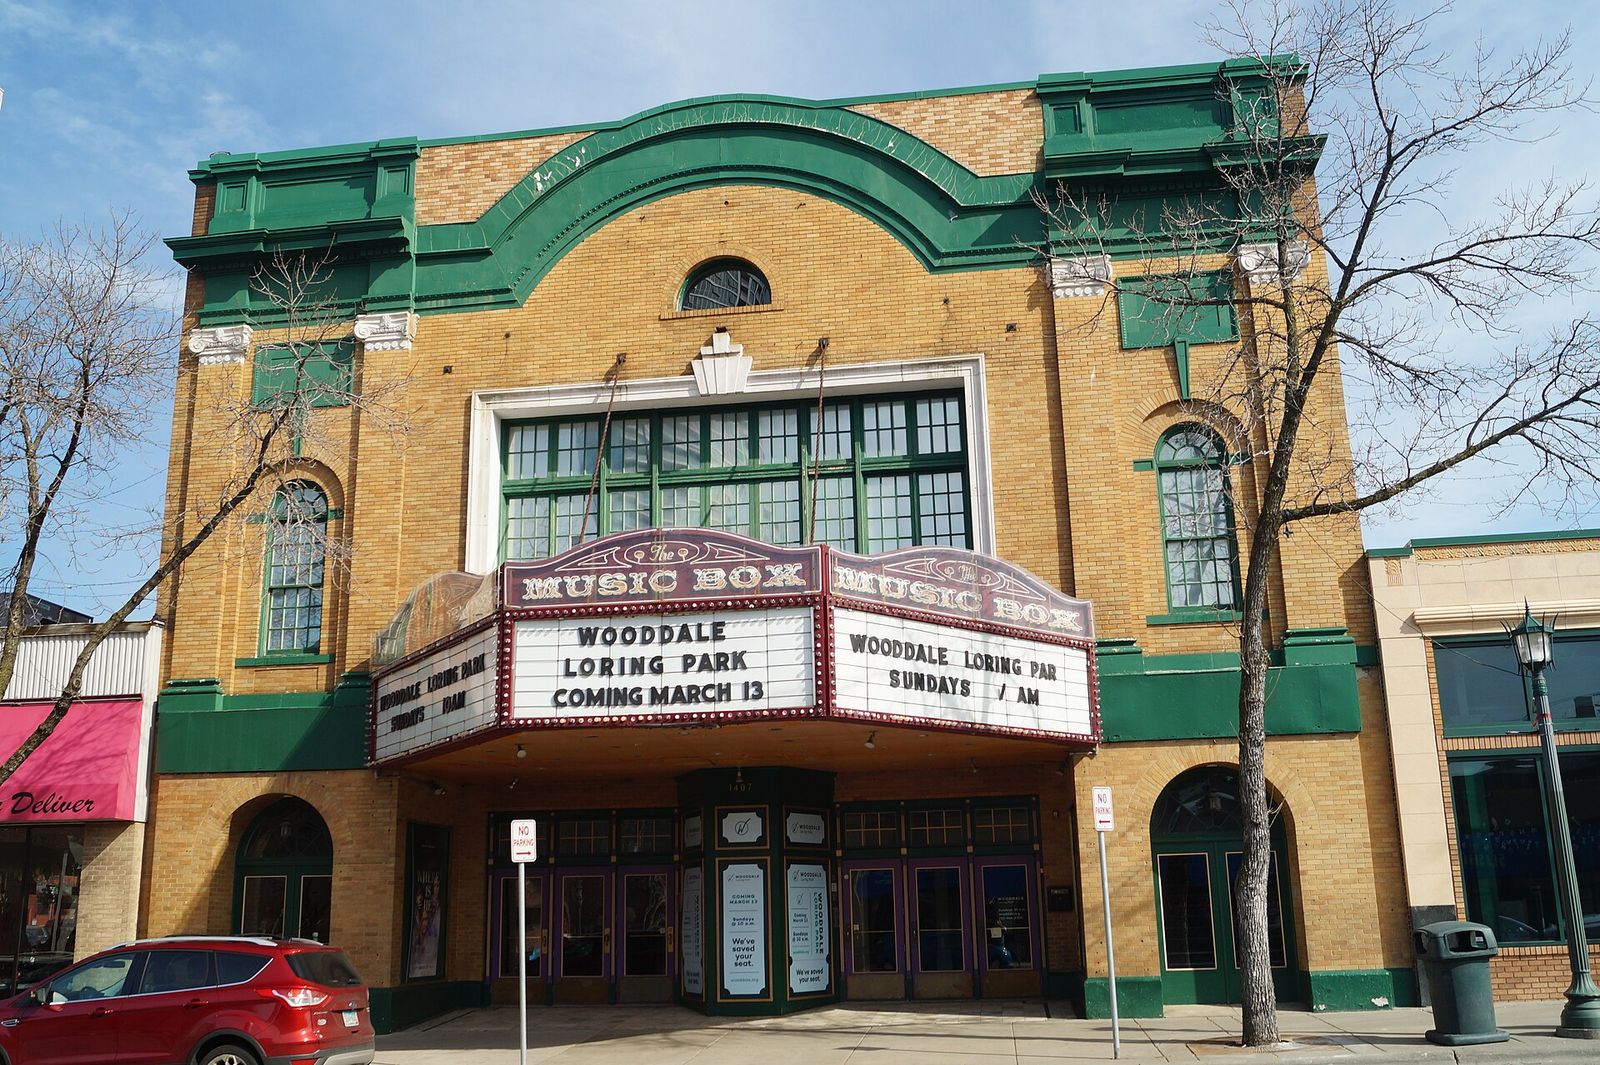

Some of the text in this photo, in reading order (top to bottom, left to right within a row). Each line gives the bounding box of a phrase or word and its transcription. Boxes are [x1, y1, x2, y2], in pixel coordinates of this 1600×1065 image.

[649, 544, 675, 561] The
[522, 562, 807, 600] MUSIC BOX
[833, 566, 1083, 632] MUSIC BOX
[577, 621, 727, 646] WOODDALE
[564, 650, 748, 677] LORING PARK
[850, 633, 1058, 682] WOODDALE LORING PAR
[380, 653, 486, 713] WOODDALE LORING PARK
[553, 681, 764, 708] COMING MARCH 13
[889, 669, 971, 698] SUNDAYS
[1017, 686, 1040, 706] AM
[390, 705, 425, 733] SUNDAYS
[728, 783, 753, 792] 1407
[1097, 793, 1108, 804] NO
[11, 791, 95, 815] Deliver
[513, 838, 535, 847] PARKING
[518, 825, 530, 836] NO
[731, 937, 756, 945] We've
[733, 960, 754, 968] seat.
[734, 953, 753, 961] your
[798, 977, 810, 985] your
